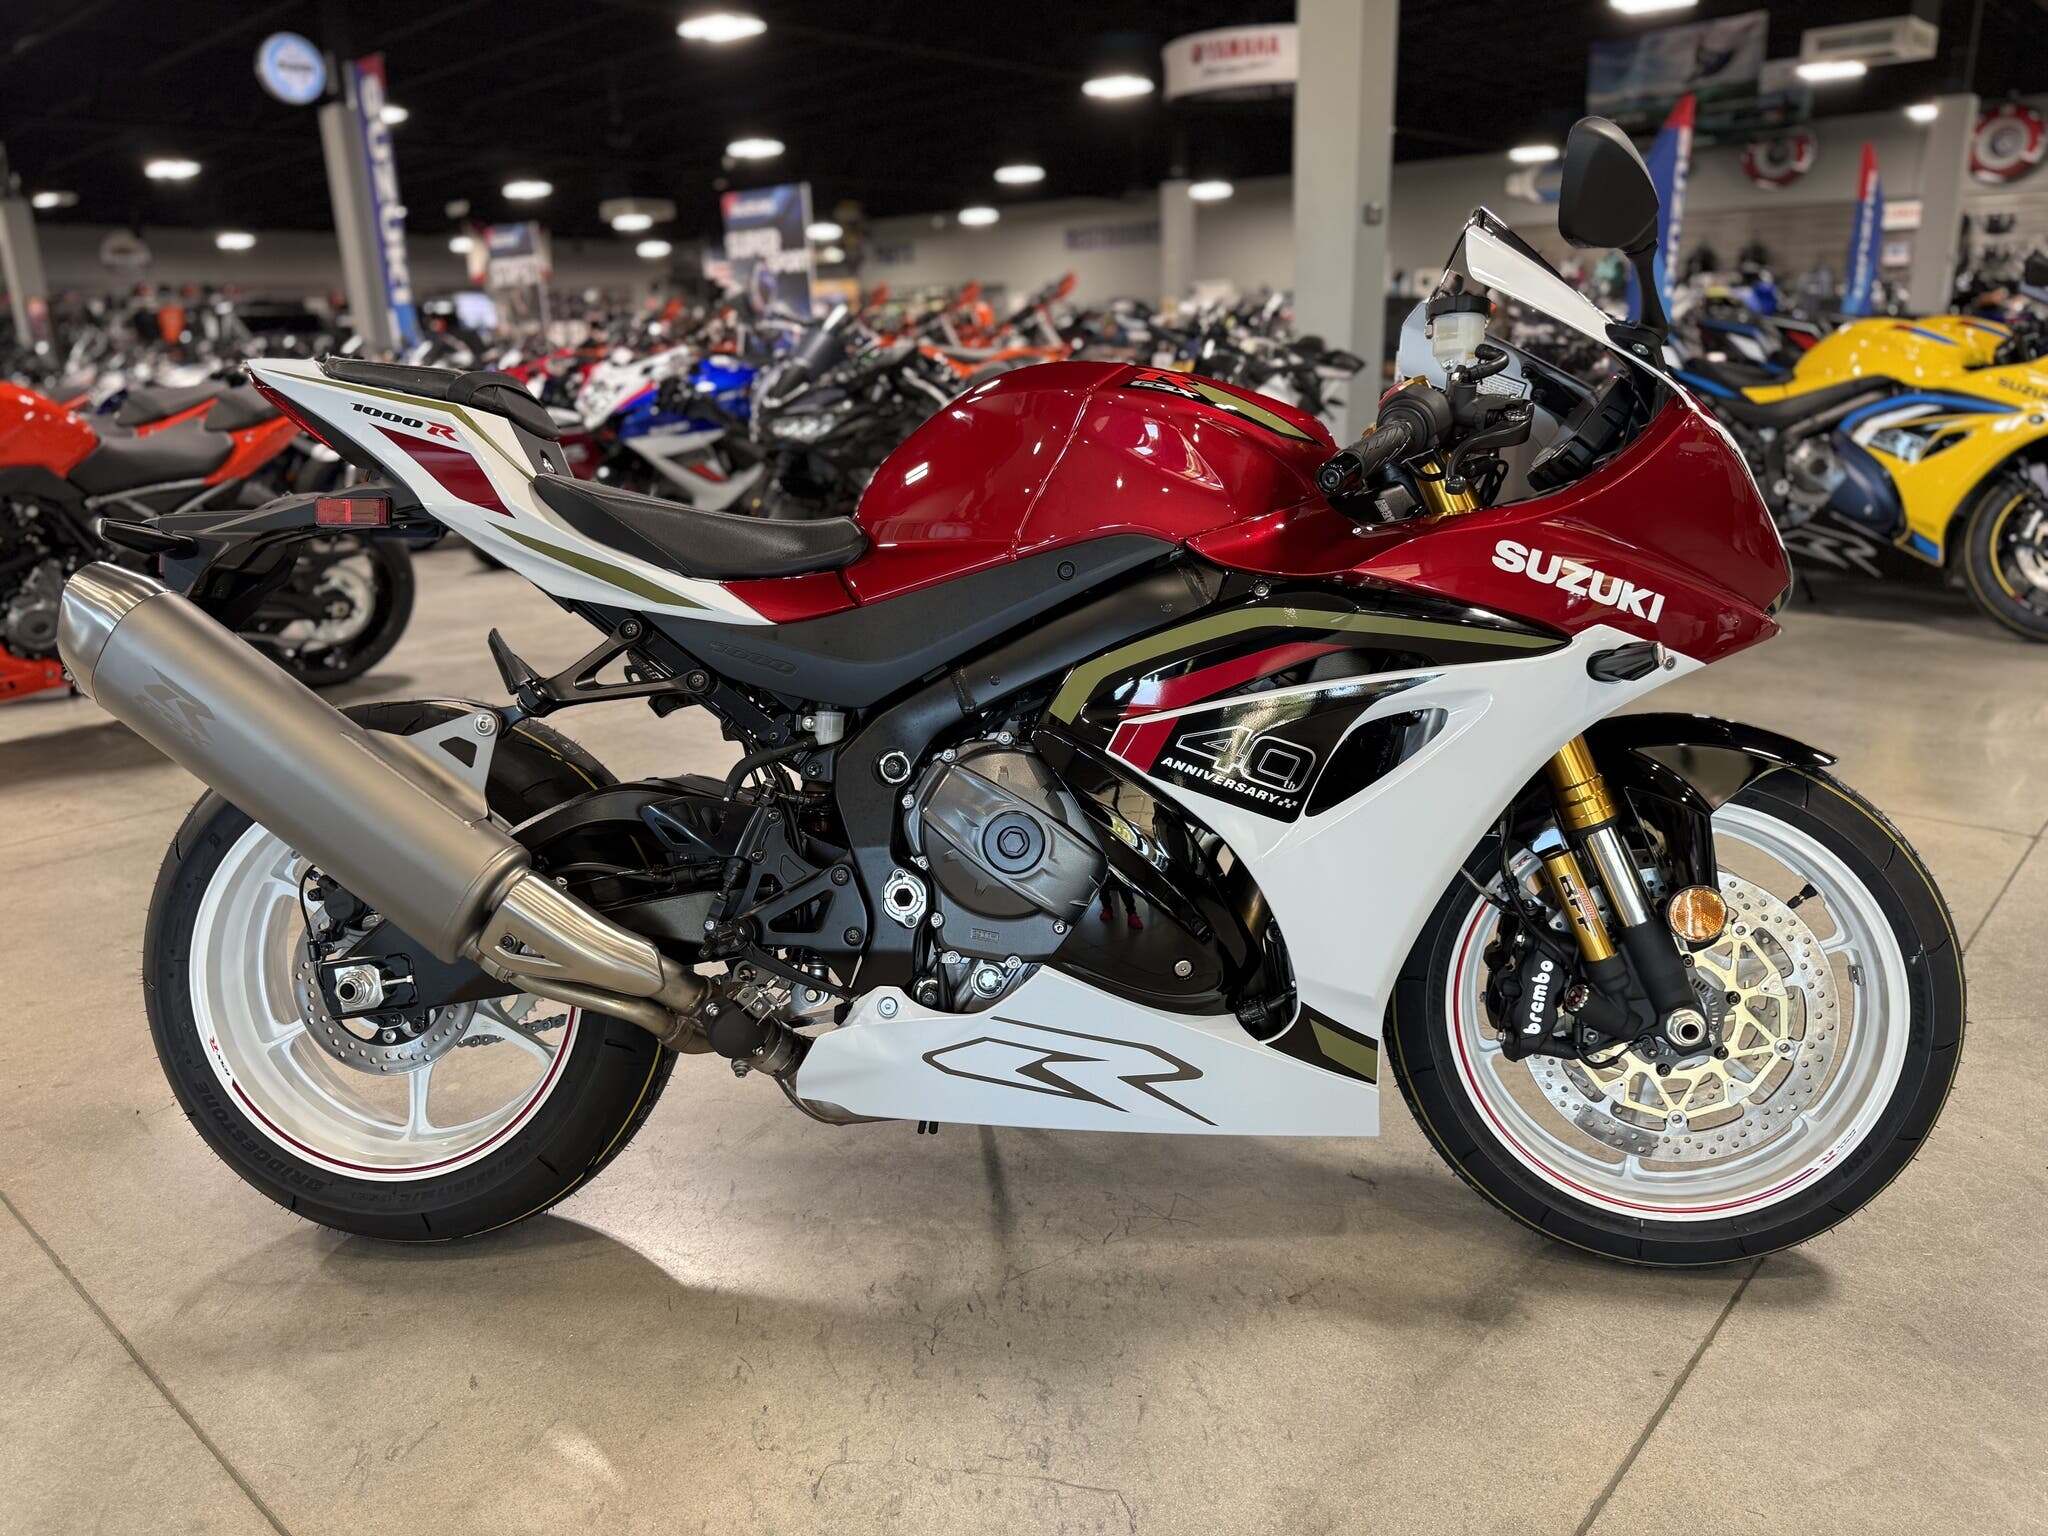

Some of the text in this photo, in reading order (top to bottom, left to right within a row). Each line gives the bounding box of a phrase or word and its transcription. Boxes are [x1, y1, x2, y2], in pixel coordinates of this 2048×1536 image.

[360, 73, 412, 305] SUZUKI
[1491, 540, 1665, 624] SUZUKI
[1161, 757, 1281, 804] ANNIVERSARY
[1523, 960, 1554, 1035] brembo
[194, 1080, 325, 1194] BRIDGESTONE
